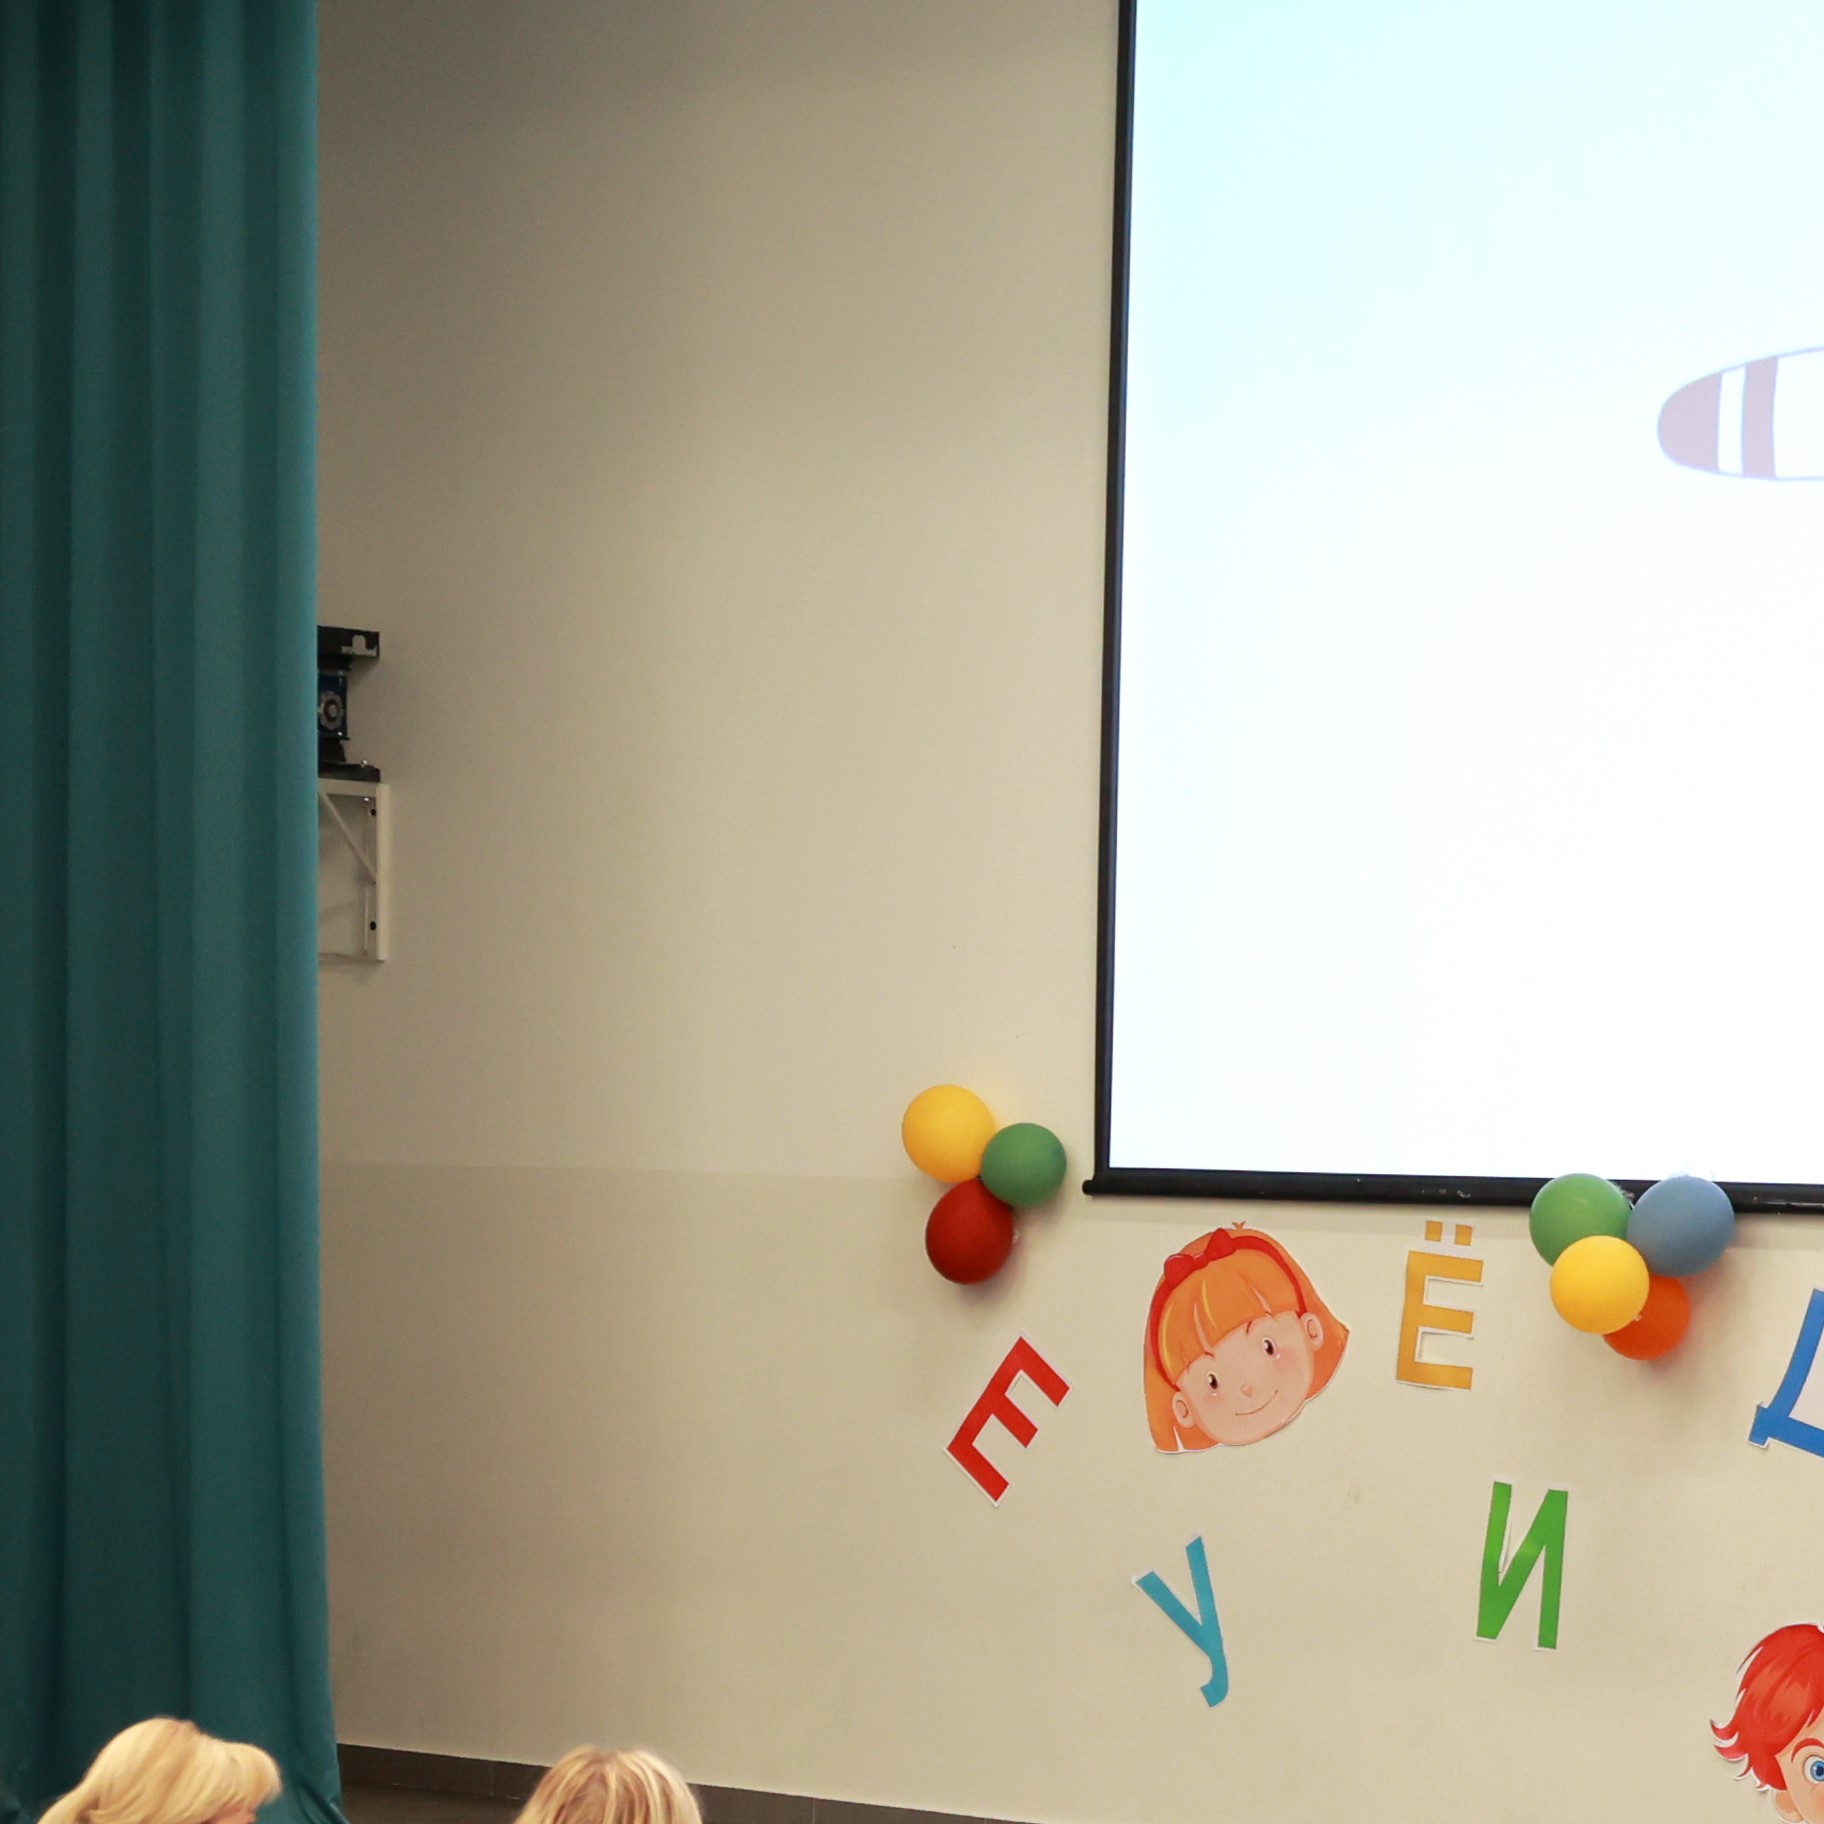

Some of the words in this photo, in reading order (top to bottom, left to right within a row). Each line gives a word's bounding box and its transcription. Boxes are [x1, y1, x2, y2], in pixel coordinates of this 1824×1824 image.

[1394, 1219, 1485, 1391] Ё
[944, 1335, 1073, 1504] Е
[1135, 1536, 1230, 1708] У
[1475, 1480, 1569, 1651] И
